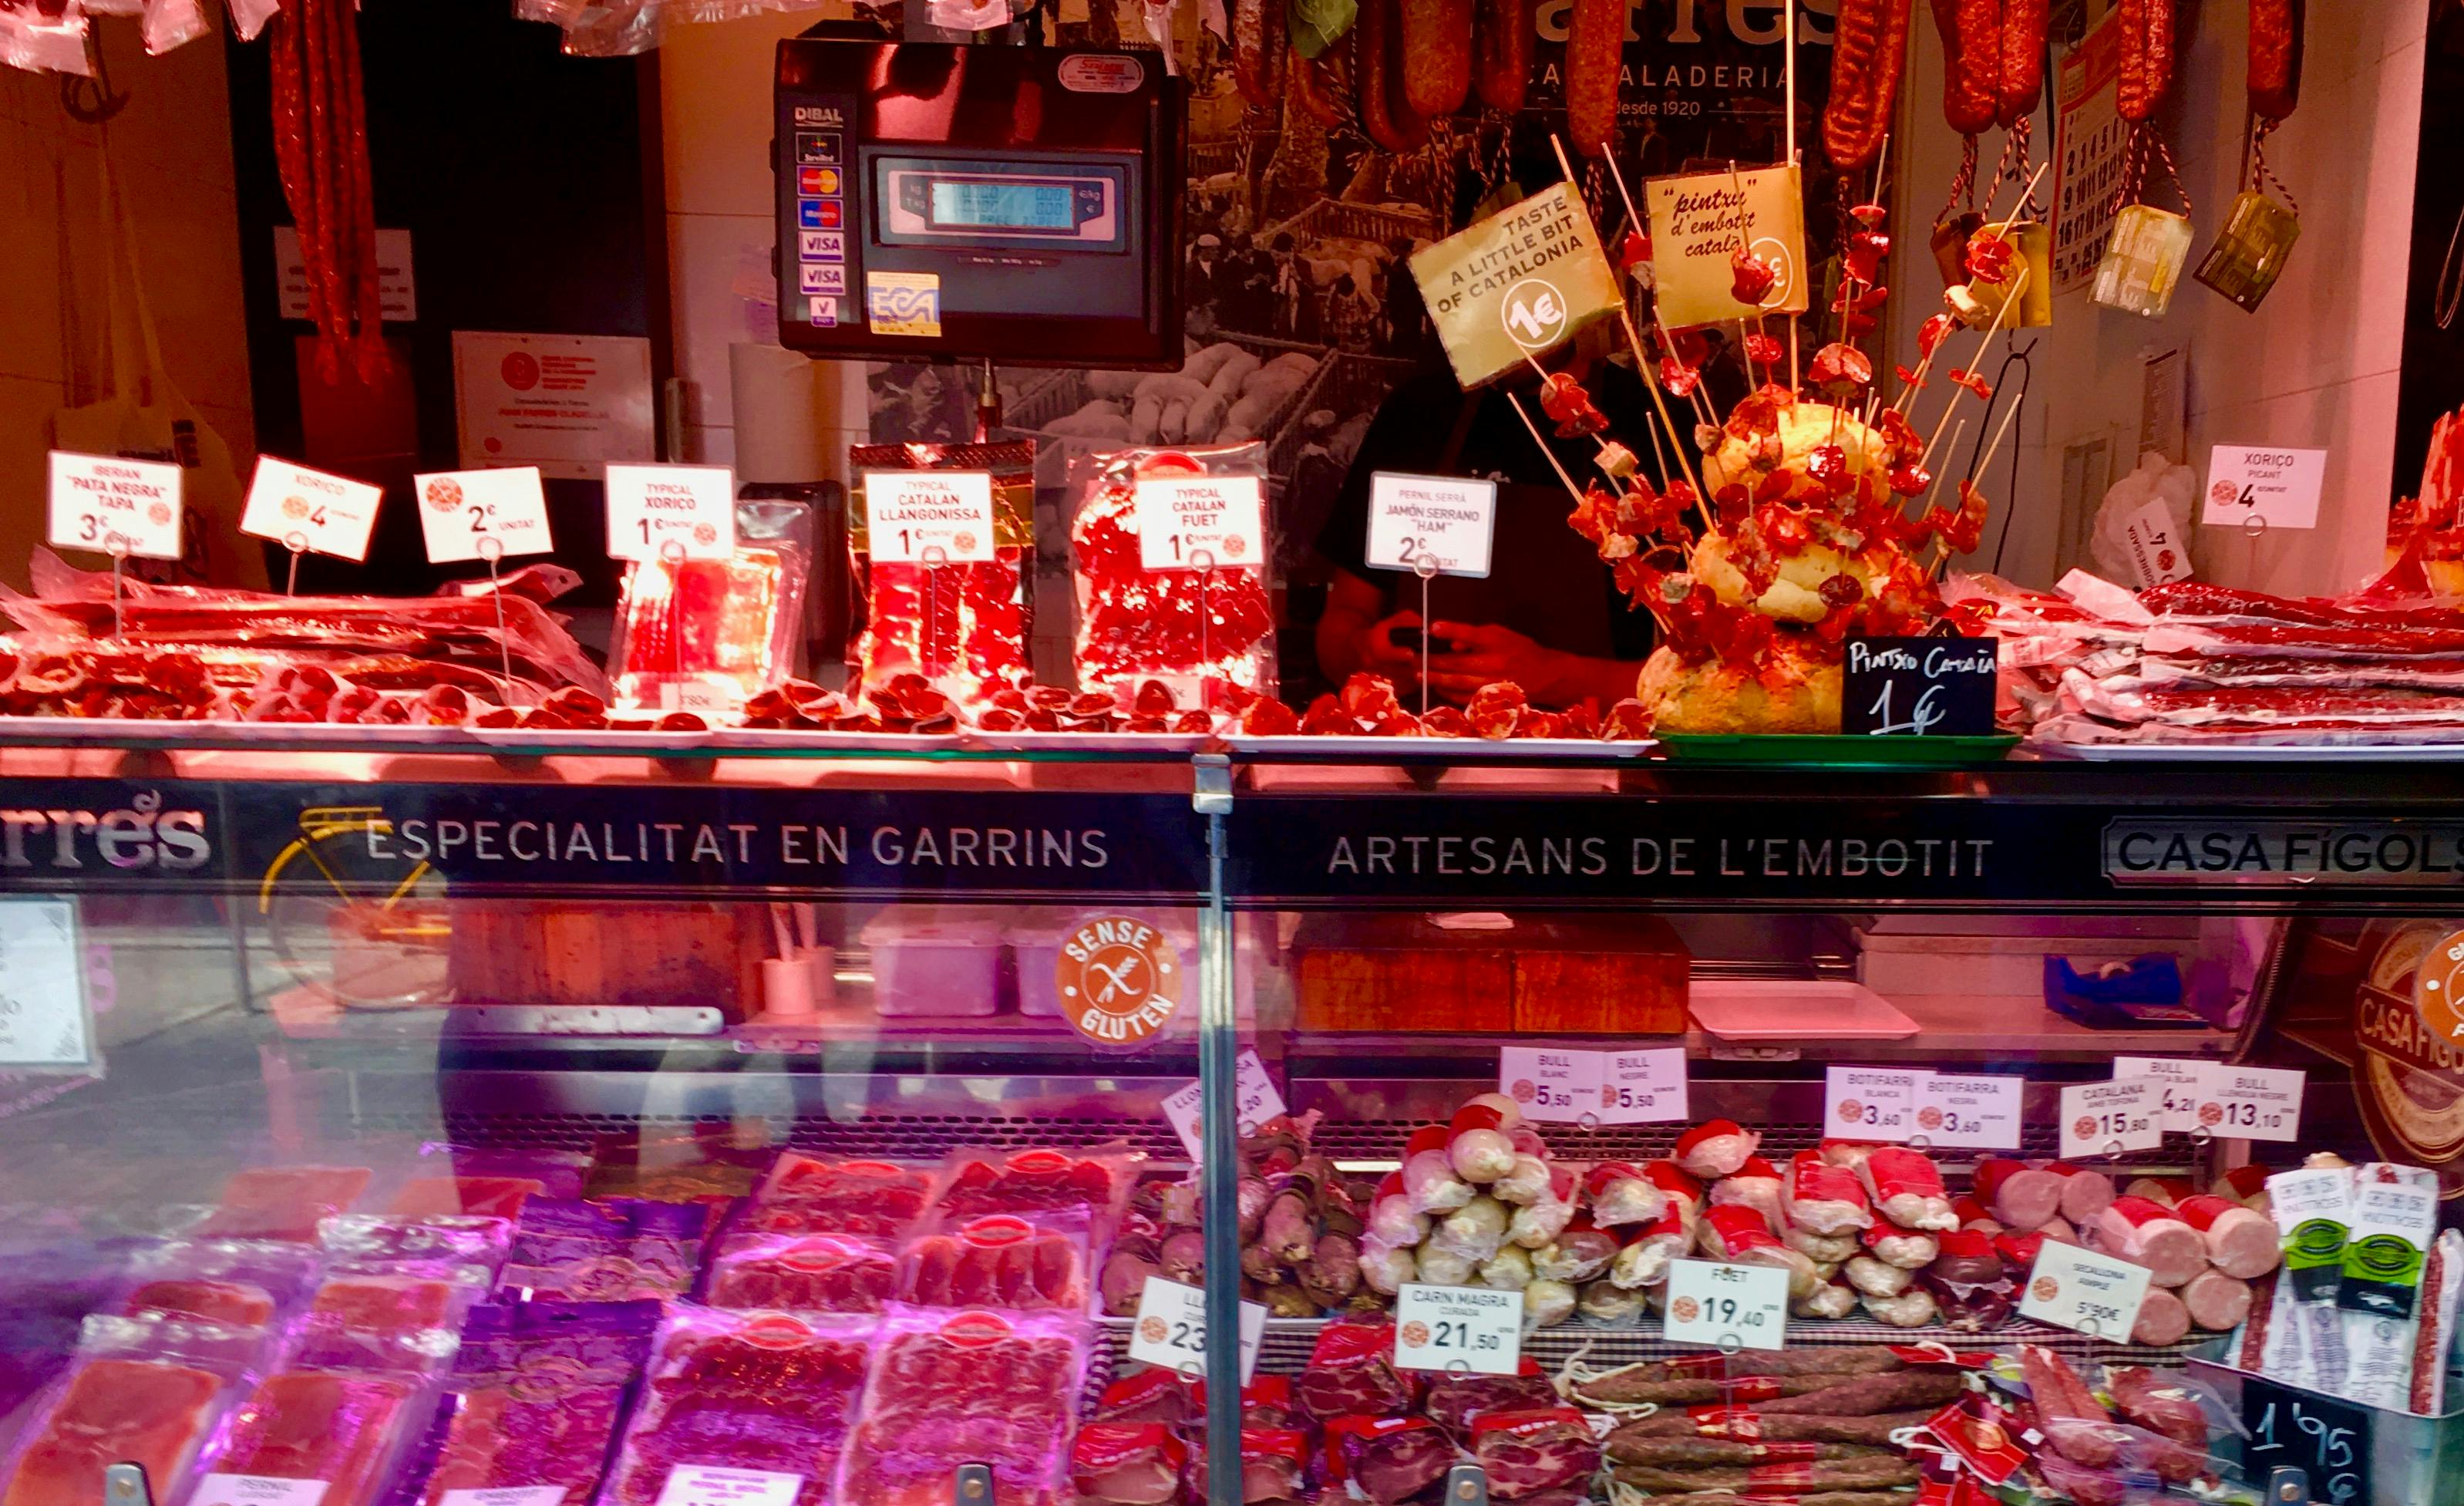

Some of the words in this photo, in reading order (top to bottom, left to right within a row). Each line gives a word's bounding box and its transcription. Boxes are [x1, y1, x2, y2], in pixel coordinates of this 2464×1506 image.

[794, 106, 844, 123] DIBAL
[1662, 102, 1701, 116] 1920
[1503, 195, 1568, 236] TASTE
[806, 237, 840, 251] VISA
[1451, 271, 1464, 286] A
[1468, 233, 1538, 278] LITTLE
[1540, 214, 1574, 241] BIT
[807, 270, 842, 284] VISA
[1437, 291, 1463, 314] OF
[1469, 234, 1584, 298] CATALONIA
[1508, 291, 1564, 339] 1€
[2244, 453, 2294, 469] XORIÇO
[92, 464, 141, 480] IBERIAN
[2247, 470, 2283, 479] PICANT
[645, 483, 693, 495] TYPICAL
[904, 480, 952, 491] TYPICAL
[897, 493, 961, 506] CATALAN
[1174, 487, 1222, 499] TYPICAL
[1398, 489, 1433, 501] PERNIL
[2238, 483, 2256, 508] 4
[97, 494, 136, 512] TAPA
[643, 496, 696, 511] XORIÇO
[1171, 500, 1227, 513] CATALAN
[309, 504, 327, 528] 4
[878, 508, 981, 521] LLANGONISSA
[1385, 503, 1425, 517] JAMÓN
[1426, 507, 1480, 522] SERRANO
[498, 518, 535, 531] UNITAT
[1181, 514, 1219, 527] FUET
[365, 818, 758, 864] ESPECIALITAT
[781, 824, 849, 865] EN
[871, 826, 1109, 869] GARRINS
[1327, 836, 1609, 876] ARTESANS
[1632, 837, 1696, 876] DE
[1718, 837, 1994, 878] L'EMBOTIT
[2118, 830, 2273, 873] CASA
[1065, 920, 1154, 963] SENSE
[1080, 992, 1175, 1040] GLUTEN
[2360, 998, 2415, 1054] CASA
[1537, 1055, 1572, 1067] BULL
[1616, 1057, 1651, 1069] BULL
[2149, 1061, 2183, 1073] BULL
[1539, 1070, 1569, 1079] BLANC
[1846, 1073, 1914, 1087] BOTIFARR
[1927, 1081, 2001, 1095] BOTIFARRA
[2234, 1077, 2270, 1090] BULL
[1863, 1089, 1900, 1099] BLANCA
[2082, 1083, 2146, 1100] CATALANA
[1711, 1267, 1750, 1283] FUET
[1412, 1289, 1455, 1303] CARN
[1456, 1292, 1510, 1309] MAGRA
[1438, 1306, 1481, 1317] CURADA
